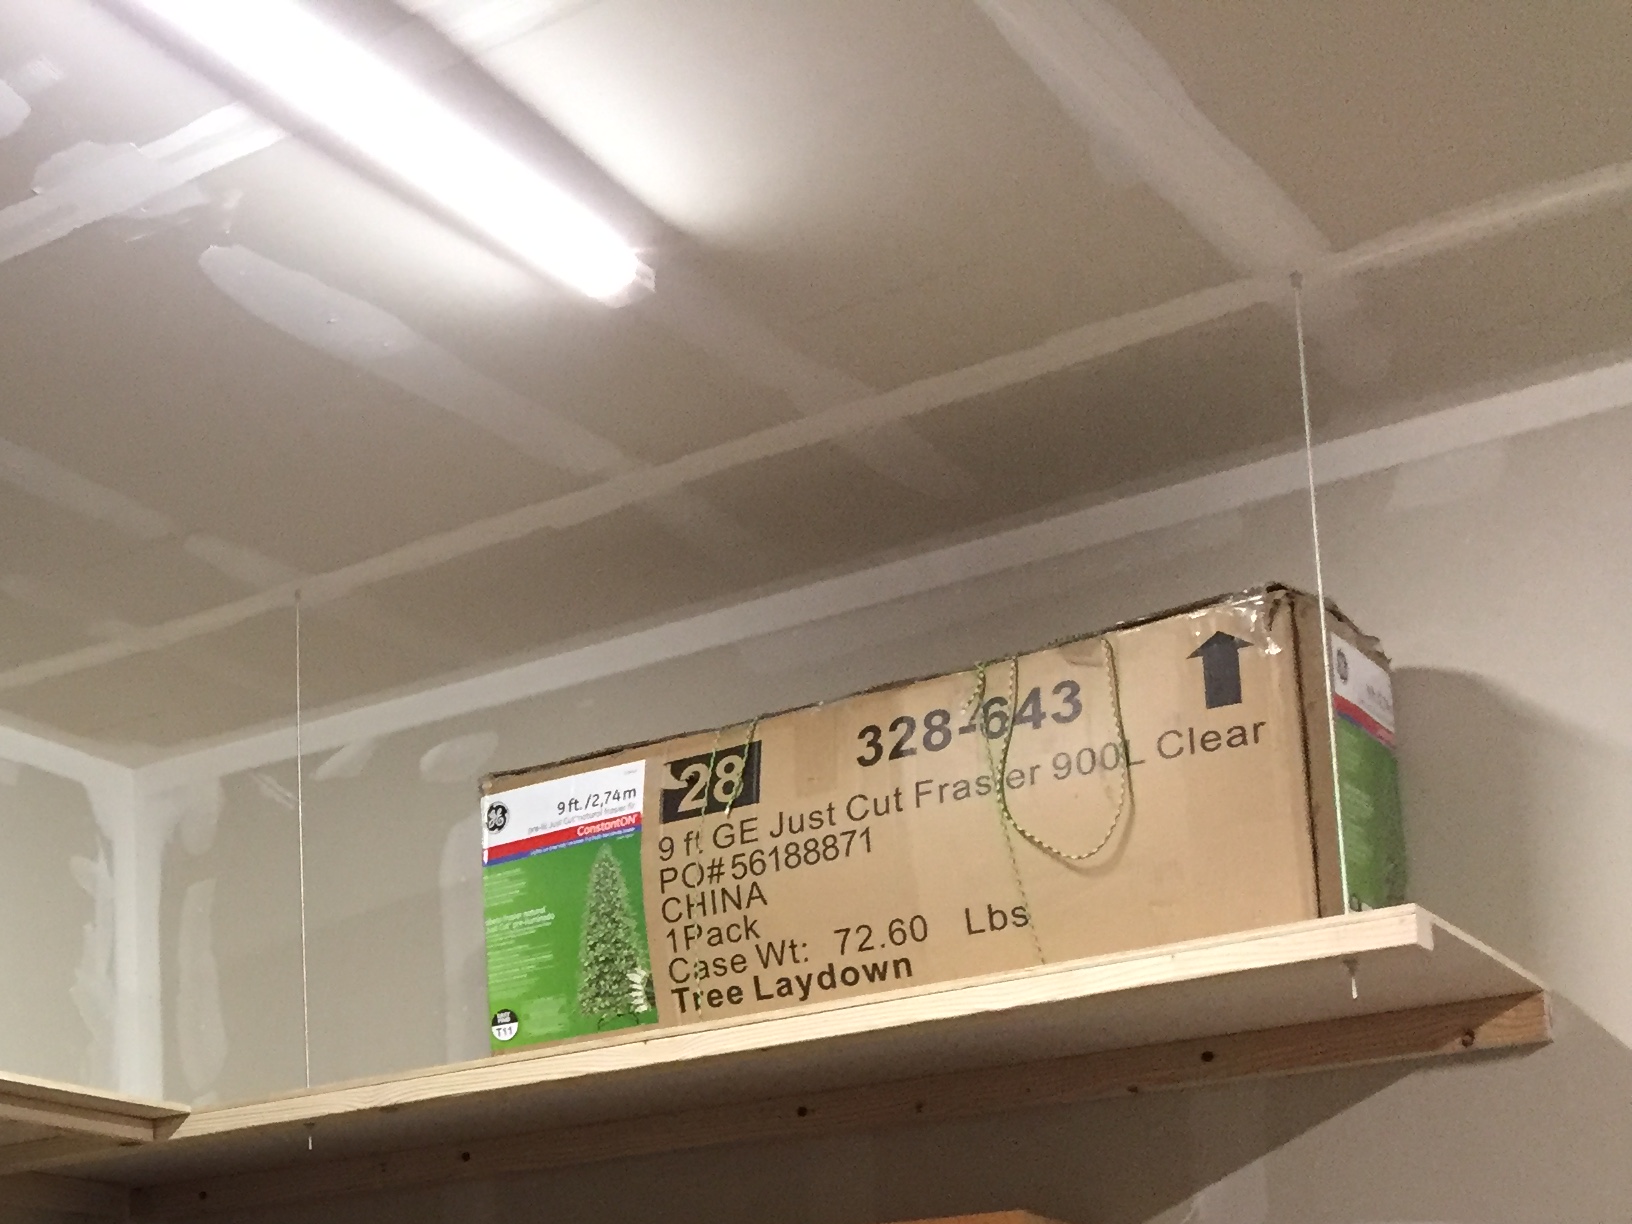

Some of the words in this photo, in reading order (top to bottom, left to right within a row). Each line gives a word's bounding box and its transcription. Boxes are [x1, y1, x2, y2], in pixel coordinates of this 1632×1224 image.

[856, 680, 1083, 768] 328-643
[658, 836, 675, 862] 9
[712, 817, 760, 850] GE
[769, 802, 837, 839] Just
[845, 786, 904, 822] Cut
[915, 763, 1041, 809] Fraser
[1156, 721, 1267, 760] Clear
[677, 755, 746, 814] 28
[661, 881, 768, 924] CHINA
[666, 914, 761, 954] 1Pack
[668, 952, 749, 984] Case
[755, 938, 809, 970] Wt:
[833, 914, 929, 956] 72.60
[964, 903, 1031, 936] Lbs
[670, 984, 744, 1014] Tree
[752, 955, 913, 1002] Laydown
